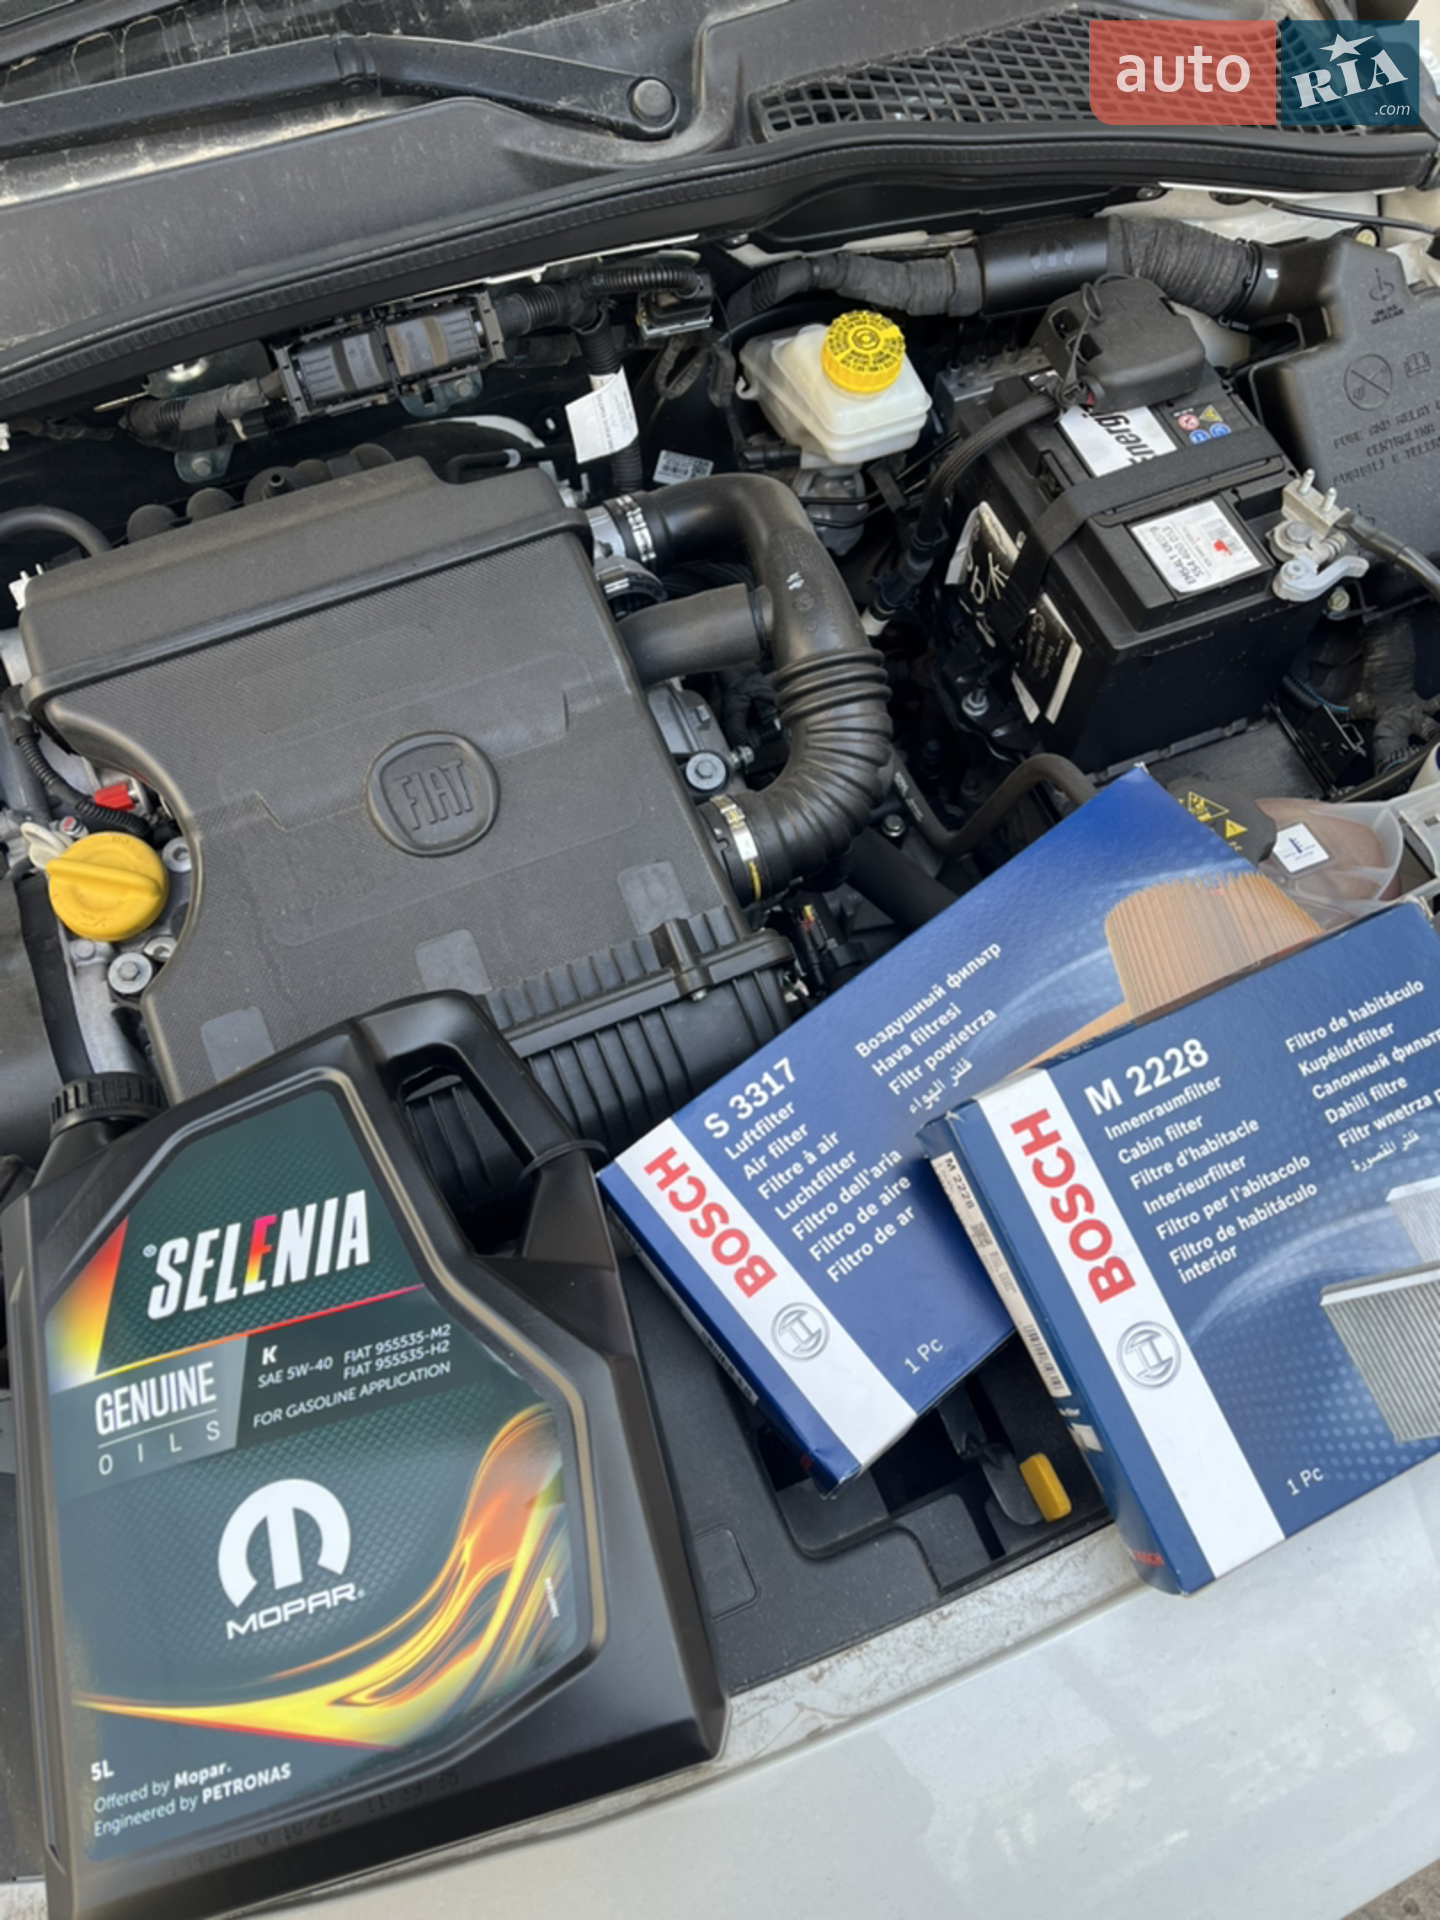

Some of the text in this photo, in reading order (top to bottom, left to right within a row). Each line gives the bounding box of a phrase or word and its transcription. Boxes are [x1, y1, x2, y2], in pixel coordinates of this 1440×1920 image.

[393, 759, 473, 830] FIAT
[855, 943, 1001, 1058] Воздушный фильтр
[1285, 980, 1425, 1053] Filtro de habitáculo
[871, 1002, 962, 1077] Hava filtresi
[888, 1008, 998, 1095] Filtr powietrza
[1298, 1022, 1394, 1077] Kupéluftfilter
[703, 1057, 796, 1139] S 3317
[1084, 1038, 1209, 1116] M 2228
[1104, 1075, 1222, 1140] Innenraumfilter
[1312, 1052, 1391, 1100] Салонный
[1324, 1076, 1408, 1125] Dahili filtre
[724, 1101, 795, 1160] Luftfilter
[742, 1122, 809, 1181] Air filter
[1117, 1114, 1204, 1164] Cabin filter
[1129, 1117, 1260, 1190] Filtre d'habitacle
[1337, 1122, 1371, 1148] Filtr
[1373, 1094, 1433, 1132] wnetrza
[757, 1131, 840, 1200] Filtre à air
[774, 1151, 857, 1220] Luchtfilter
[791, 1201, 839, 1241] Filtro
[838, 1150, 903, 1204] dell'aria
[945, 1157, 975, 1209] M 2228
[1142, 1154, 1247, 1216] Interieurfilter
[1155, 1155, 1311, 1241] Filtro per l'abitacolo
[643, 1147, 777, 1298] BOSCH
[808, 1222, 856, 1262] Filtro
[856, 1203, 879, 1224] de
[878, 1176, 911, 1206] aire
[1010, 1108, 1136, 1303] BOSCH
[1169, 1182, 1318, 1267] Filtro de habitáculo
[147, 1189, 370, 1319] SELENIA
[825, 1206, 915, 1283] Filtro de ar
[1177, 1245, 1238, 1284] interior
[257, 1356, 333, 1388] SAE 5W-40
[262, 1345, 278, 1366] K
[343, 1340, 450, 1380] FIAT 955535-H2
[344, 1324, 451, 1364] FIAT 955535-M2
[904, 1339, 943, 1375] 1 Pc
[95, 1361, 217, 1435] GENUINE
[253, 1361, 451, 1428] FOR GASOLINE APPLICATION
[1287, 1468, 1324, 1496] 1 Pc
[226, 1582, 358, 1640] MOPAR
[91, 1759, 114, 1782] 5L
[94, 1784, 148, 1814] Offered
[152, 1779, 170, 1797] by
[94, 1762, 292, 1837] Engineered by PETRONAS
